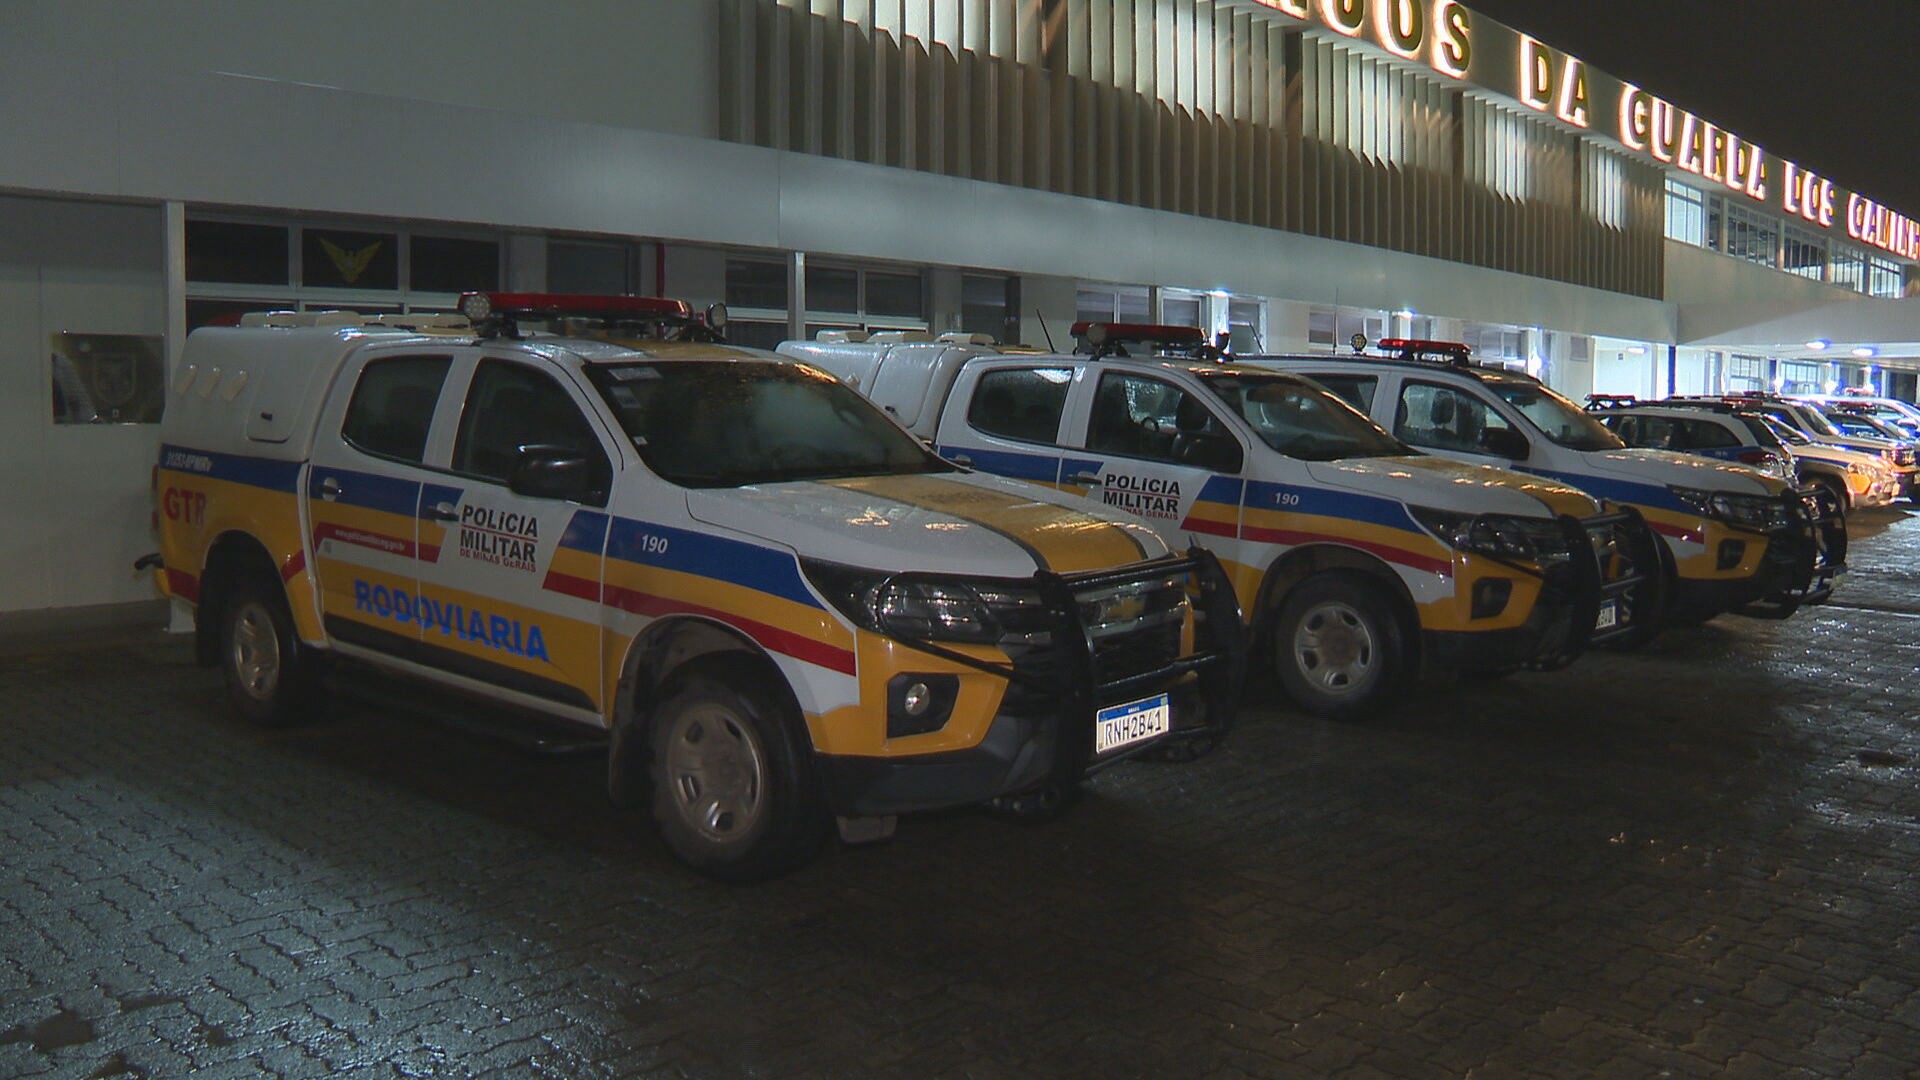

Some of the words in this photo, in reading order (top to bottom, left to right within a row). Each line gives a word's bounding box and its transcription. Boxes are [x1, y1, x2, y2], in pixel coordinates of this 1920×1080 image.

[1521, 34, 1590, 127] DA
[1619, 81, 1766, 200] GUARDA
[1103, 490, 1179, 513] MILITAR
[1275, 492, 1300, 506] 190
[460, 528, 536, 562] MILITAR
[641, 534, 668, 553] 190
[459, 548, 471, 558] DE
[473, 551, 500, 565] MINAS
[503, 557, 537, 573] GERAIS
[354, 578, 550, 663] RODOVIARIA
[1105, 709, 1162, 746] RNH2B41
